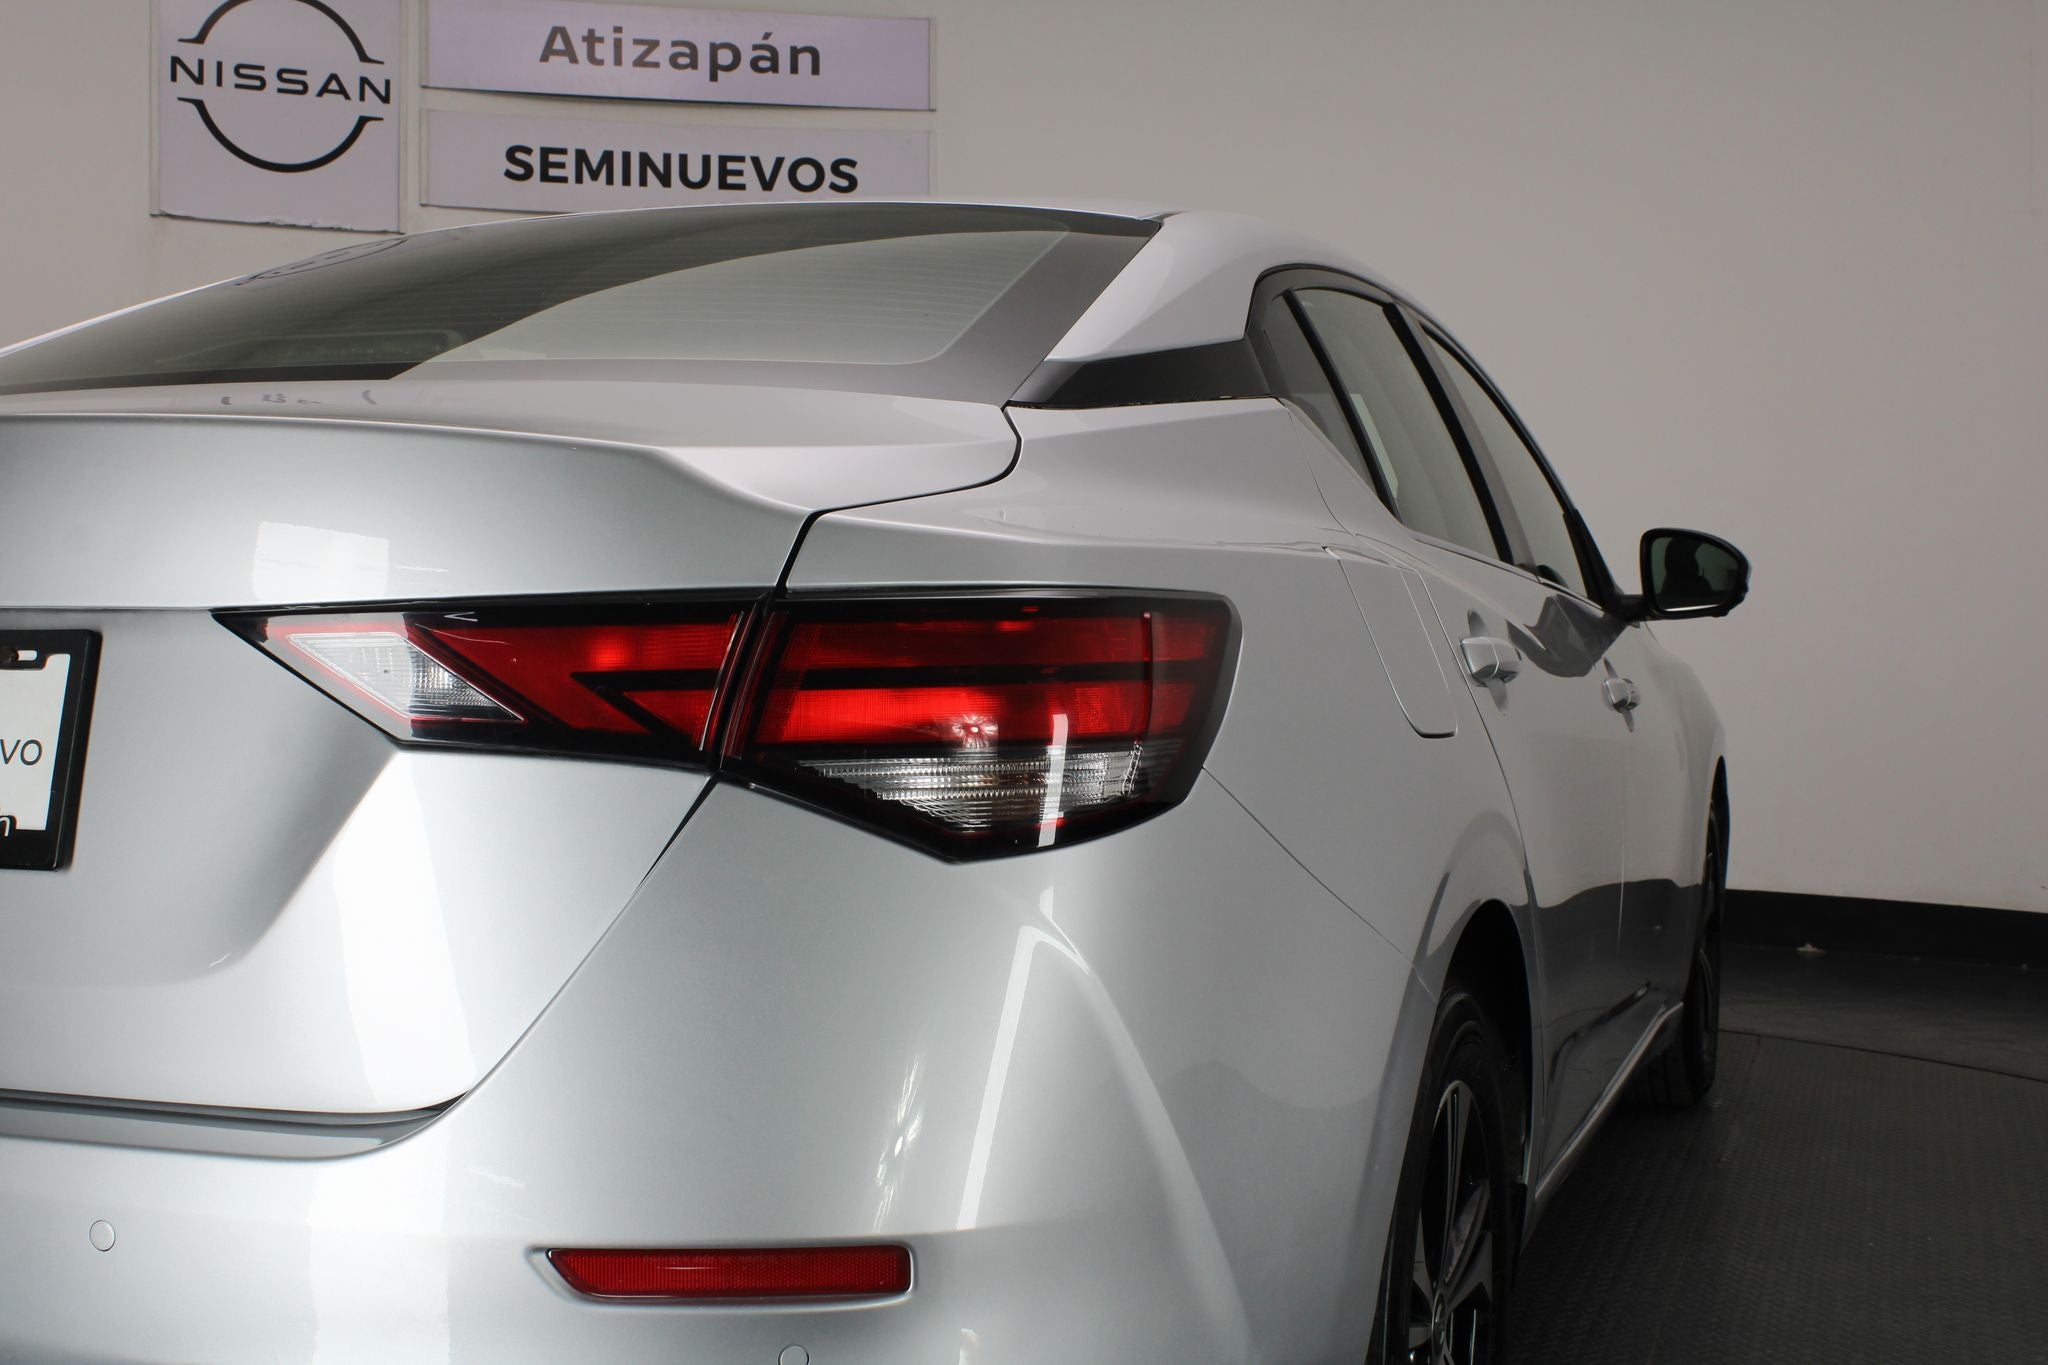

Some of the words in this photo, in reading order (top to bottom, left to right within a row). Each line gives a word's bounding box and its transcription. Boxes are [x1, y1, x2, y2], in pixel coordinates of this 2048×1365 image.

[539, 25, 821, 83] Atizapán
[170, 55, 391, 105] NISSAN
[503, 144, 858, 194] SEMINUEVOS
